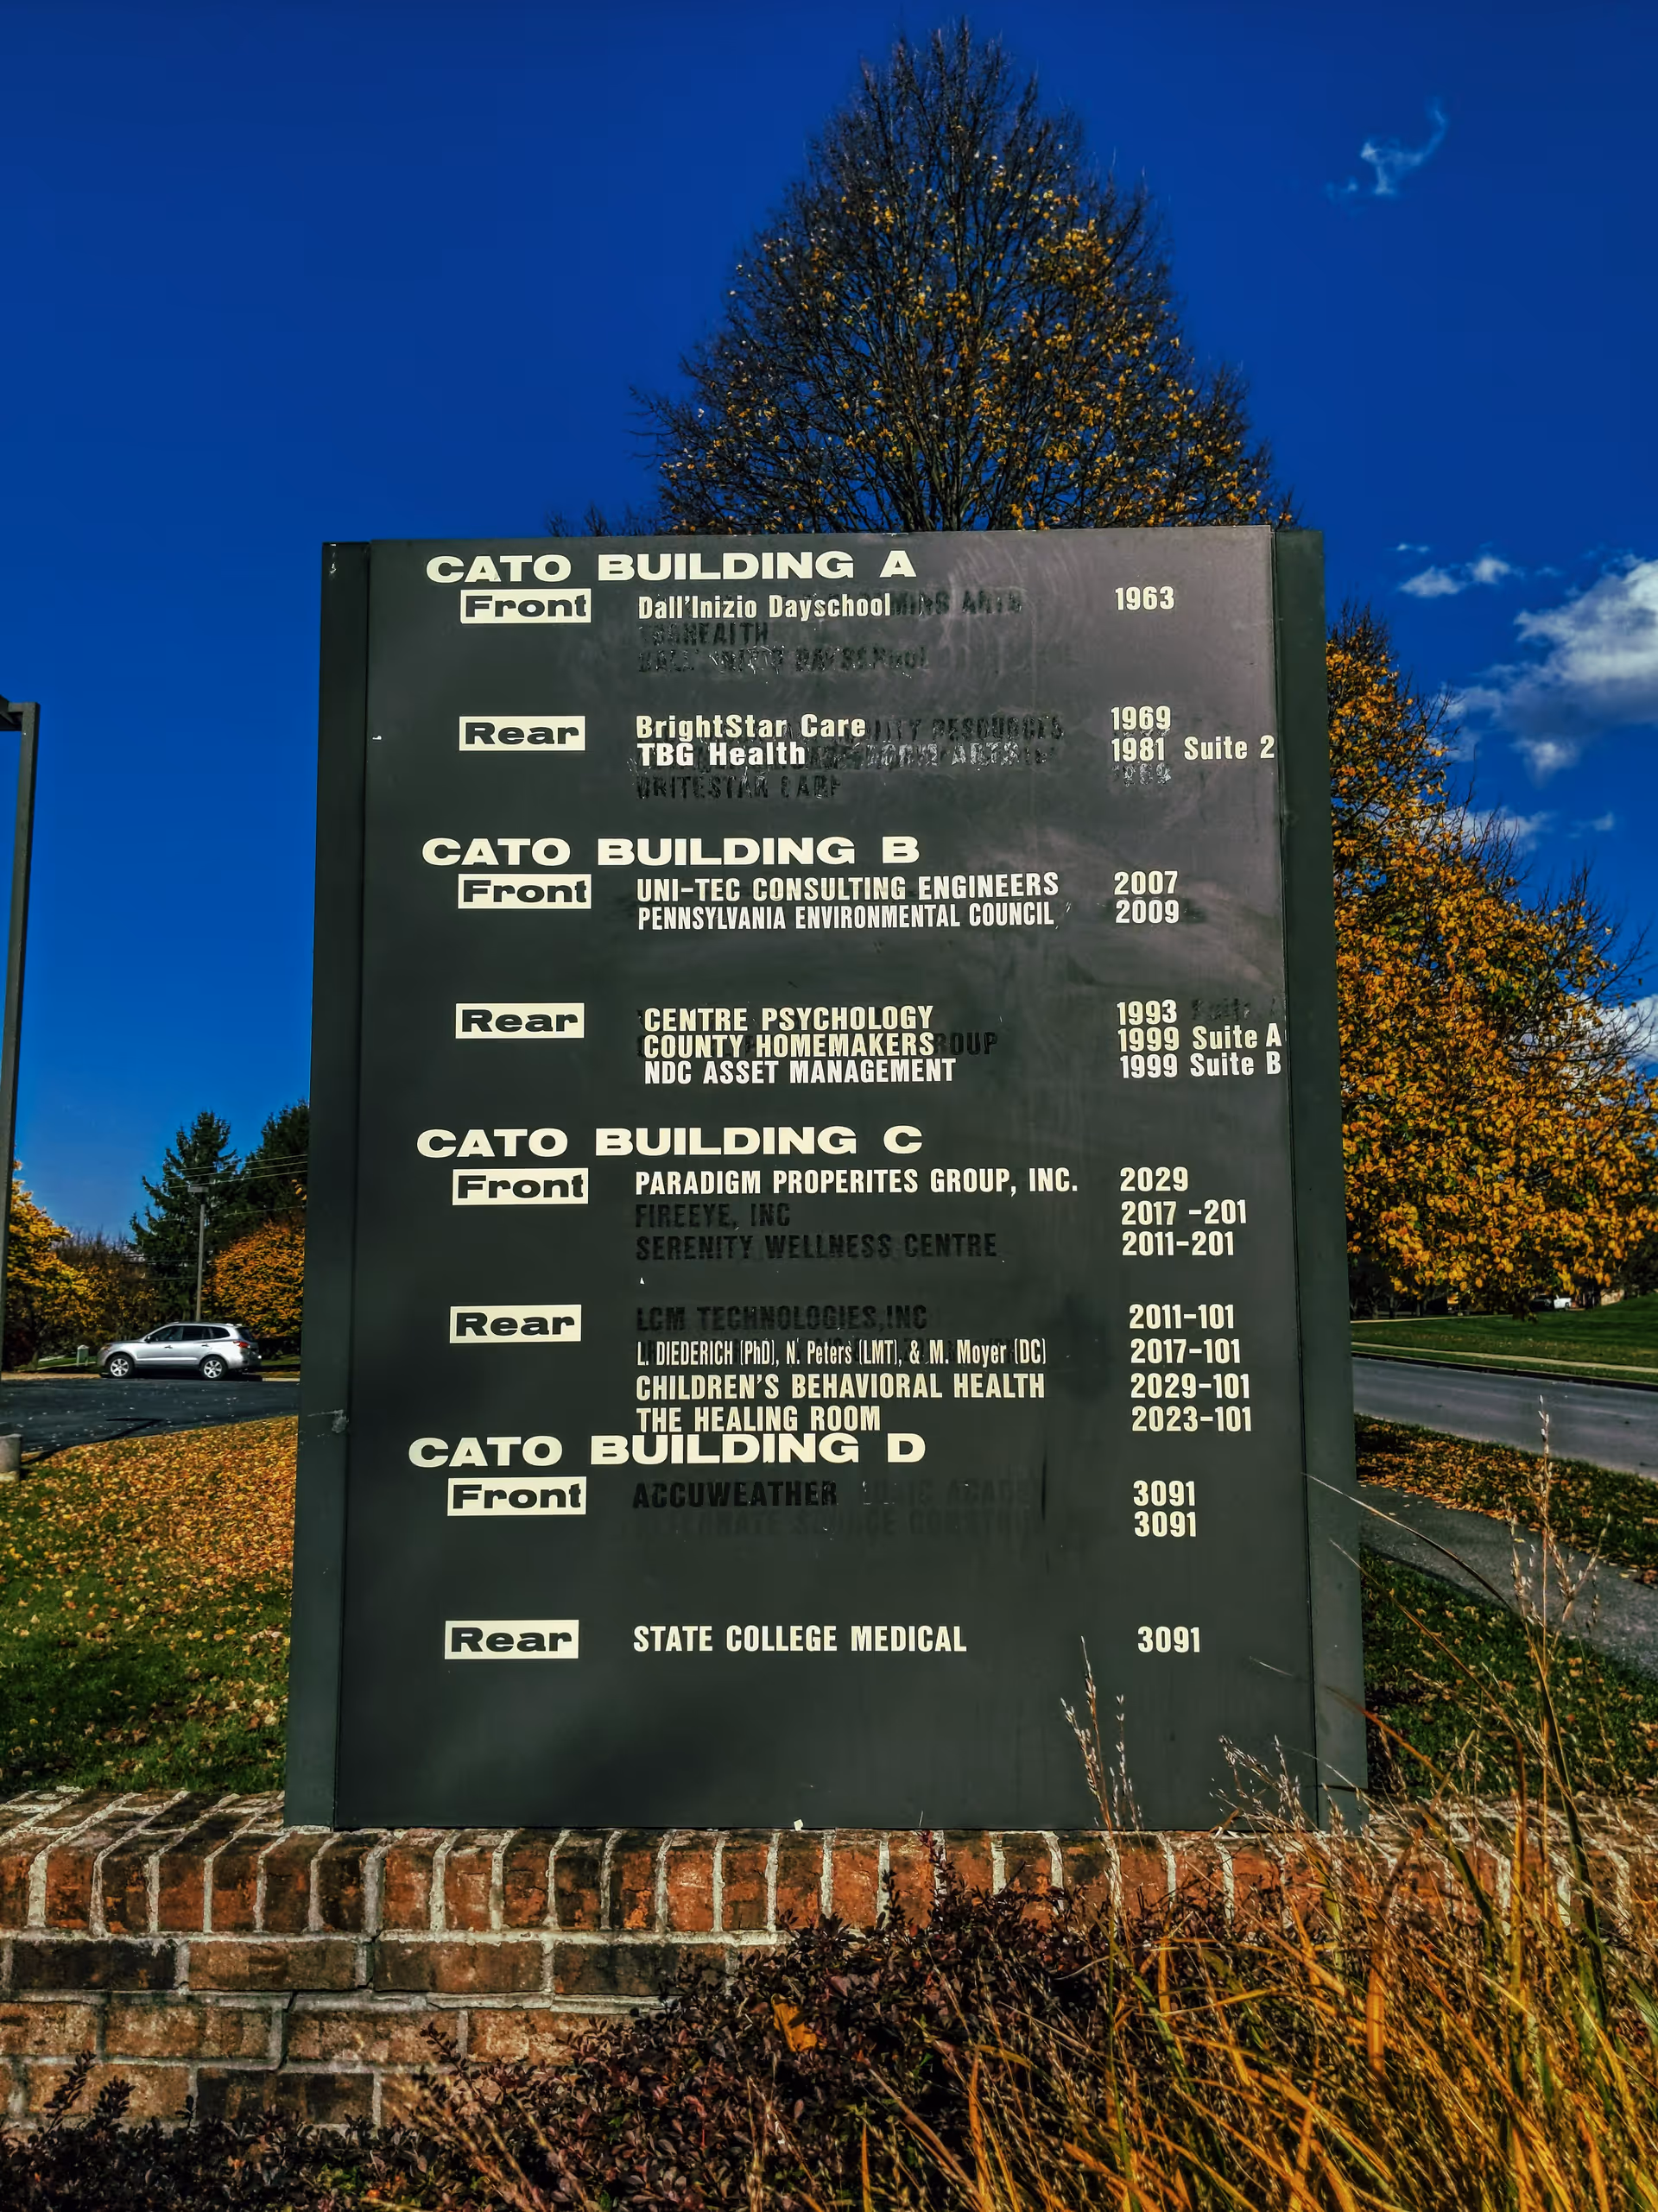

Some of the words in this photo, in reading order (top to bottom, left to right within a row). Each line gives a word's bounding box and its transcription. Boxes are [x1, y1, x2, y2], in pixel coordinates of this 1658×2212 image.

[427, 554, 571, 583] CATO
[598, 551, 853, 580] BUILDING
[880, 551, 916, 578] A
[466, 595, 585, 616] Front
[639, 596, 756, 619] Dall'Inizio
[769, 593, 890, 621] Dayschool
[1116, 586, 1174, 610] 1963
[636, 715, 787, 742] BrightStar
[801, 714, 865, 737] Care
[1111, 706, 1170, 732] 1969
[465, 723, 579, 744] Rear
[637, 743, 693, 766] TBG
[710, 742, 805, 765] Health
[1111, 737, 1164, 762] 1981
[1185, 736, 1247, 760] Suite
[1261, 735, 1274, 758] 2
[422, 838, 570, 866] CATO
[598, 837, 854, 866] BUILDING
[883, 837, 919, 863] B
[464, 880, 586, 902] Front
[637, 878, 739, 901] UNI-TEC
[753, 876, 905, 901] CONSULTING
[919, 872, 1058, 900] ENGINEERS
[1115, 871, 1177, 894] 2007
[639, 907, 786, 930] PENNSYLVANIA
[796, 904, 960, 928] ENVIRONMENTAL
[970, 902, 1054, 926] COUNCIL
[1116, 900, 1179, 923] 2009
[462, 1010, 578, 1032] Rear
[645, 1008, 747, 1032] CENTRE
[763, 1006, 933, 1031] PSYCHOLOGY
[1117, 1000, 1177, 1028] 1993
[644, 1035, 744, 1059] COUNTY
[756, 1033, 933, 1057] HOMEMAKERS
[1118, 1027, 1179, 1052] 1999
[1193, 1025, 1257, 1050] Suite
[1266, 1023, 1281, 1046] A
[645, 1061, 691, 1084] NDC
[703, 1061, 779, 1084] ASSET
[790, 1059, 956, 1083] MANAGEMENT
[1120, 1053, 1177, 1078] 1999
[1191, 1052, 1254, 1077] Suite
[1267, 1052, 1281, 1074] B
[417, 1128, 567, 1158] CATO
[596, 1126, 856, 1155] BUILDING
[883, 1126, 922, 1153] C
[459, 1175, 583, 1198] Front
[636, 1171, 760, 1195] PARADIGM
[774, 1169, 917, 1193] PROPERITES
[931, 1168, 1016, 1197] GROUP,
[1029, 1167, 1077, 1191] INC.
[1121, 1167, 1187, 1191] 2029
[634, 1203, 740, 1229] FIREEYE,
[750, 1202, 791, 1227] INC
[1122, 1201, 1176, 1225] 2017
[635, 1235, 755, 1261] SERENITY
[763, 1233, 893, 1259] WELLNESS
[904, 1232, 998, 1257] CENTRE
[1123, 1231, 1233, 1255] 2011-201
[456, 1312, 574, 1336] Rear
[1130, 1304, 1233, 1329] 2011-101
[638, 1342, 648, 1365] L.
[657, 1341, 732, 1365] DIEDERICH
[787, 1342, 801, 1365] N.
[807, 1341, 851, 1364] Peters
[909, 1340, 920, 1364] &
[930, 1340, 948, 1363] M.
[957, 1340, 1006, 1368] Moyer
[1131, 1338, 1240, 1363] 2017-101
[636, 1374, 778, 1400] CHILDREN'S
[792, 1373, 942, 1398] BEHAVIORAL
[954, 1374, 1044, 1398] HEALTH
[1131, 1373, 1249, 1399] 2029-101
[636, 1407, 681, 1432] THE
[695, 1406, 797, 1431] HEALING
[811, 1406, 880, 1431] ROOM
[1132, 1406, 1250, 1431] 2023-101
[409, 1436, 562, 1467] CATO
[591, 1433, 858, 1464] BUILDING
[888, 1433, 925, 1462] D
[453, 1484, 580, 1508] Front
[632, 1481, 838, 1508] ACCUWEATHER
[1134, 1481, 1194, 1506] 3091
[1135, 1511, 1196, 1537] 3091
[452, 1627, 572, 1652] Rear
[634, 1626, 712, 1652] STATE
[727, 1626, 837, 1652] COLLEGE
[851, 1626, 966, 1652] MEDICAL
[1138, 1627, 1199, 1653] 3091
